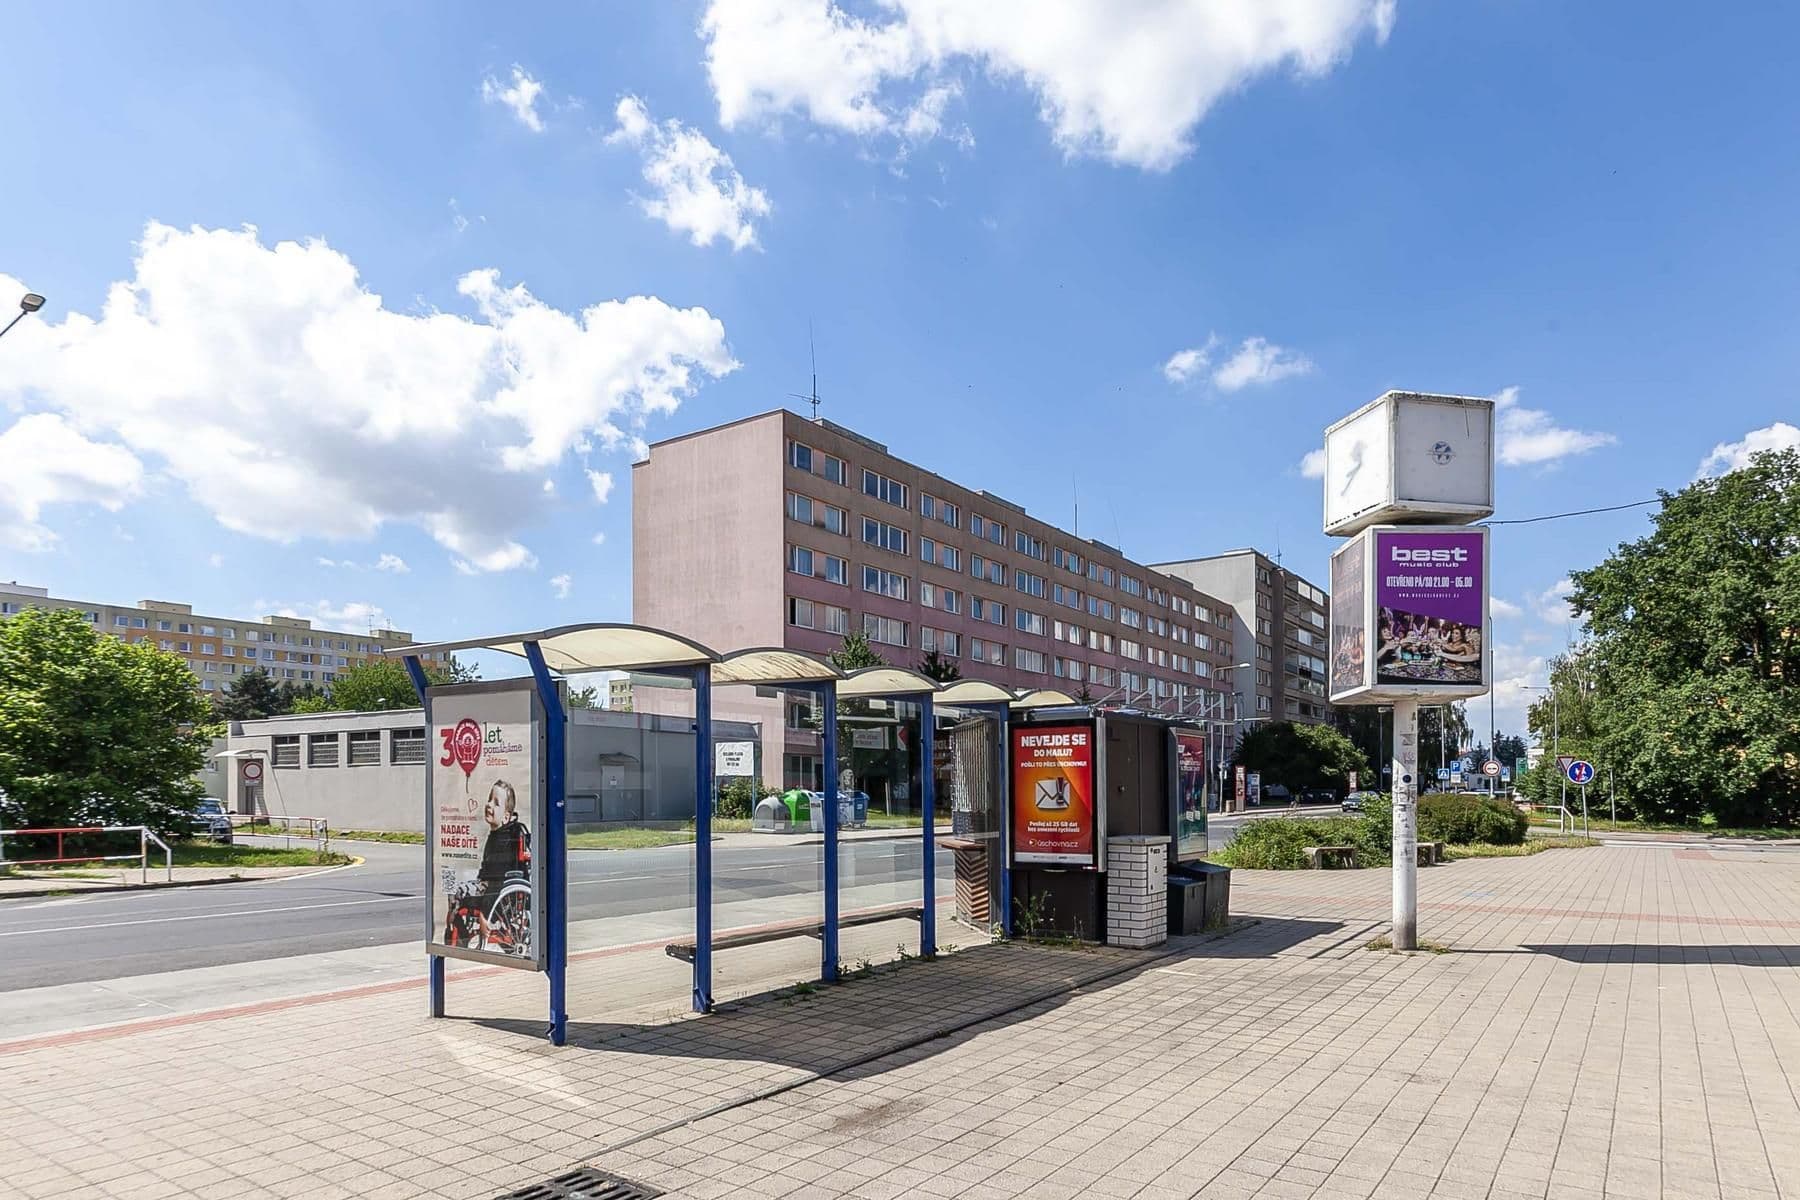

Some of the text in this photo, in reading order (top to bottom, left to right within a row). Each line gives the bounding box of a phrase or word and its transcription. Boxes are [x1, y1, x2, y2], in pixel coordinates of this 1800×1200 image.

[1392, 546, 1467, 561] best
[482, 722, 502, 744] let
[1021, 734, 1086, 747] NEVEJDE SE
[1034, 748, 1072, 757] DO MAILU?
[441, 824, 470, 834] NADACE
[441, 836, 478, 848] NAŠE DÍTĚ
